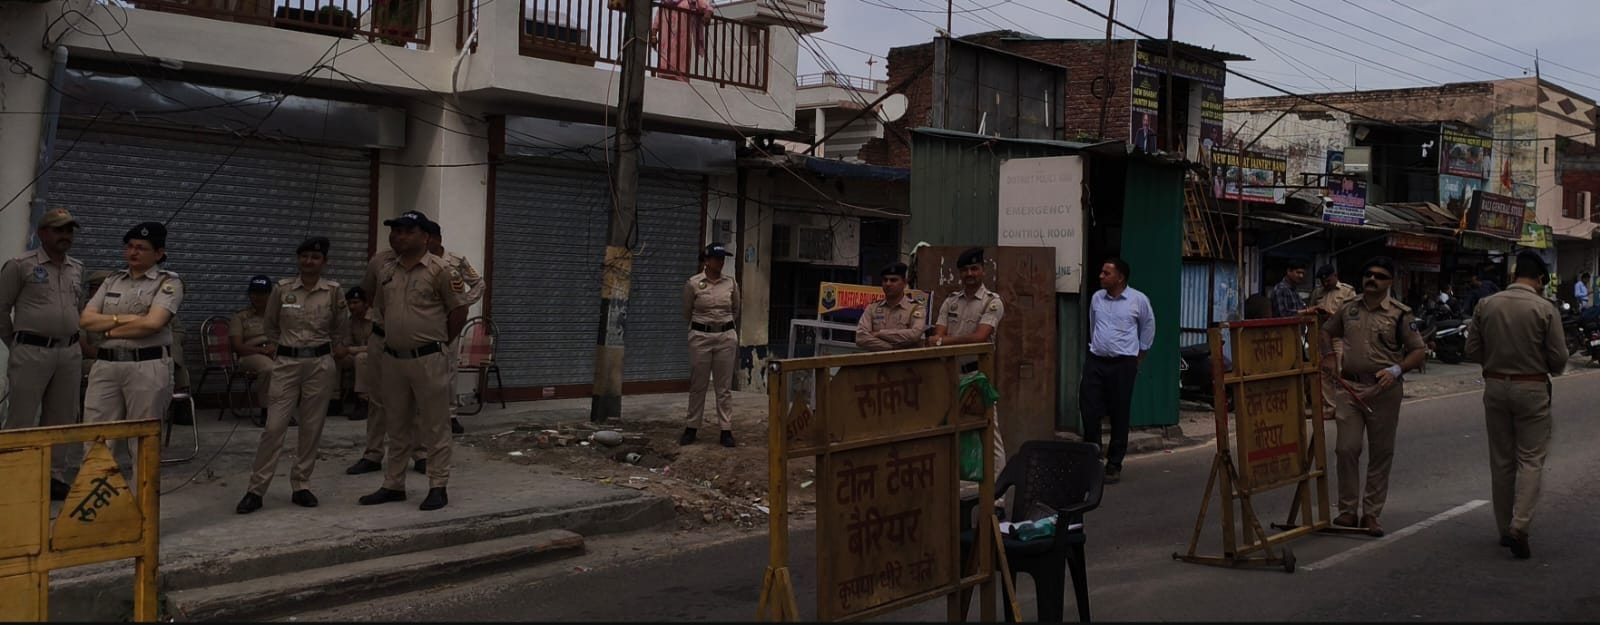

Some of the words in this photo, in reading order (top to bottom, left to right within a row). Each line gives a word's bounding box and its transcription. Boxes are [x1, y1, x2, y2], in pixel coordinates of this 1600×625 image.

[1212, 152, 1226, 165] NEW
[1227, 154, 1250, 168] BHAAT
[1006, 204, 1072, 216] EMERGENCY
[1492, 202, 1511, 215] GENERAL
[1002, 229, 1044, 239] CONTROL
[1047, 228, 1075, 238] ROOM
[785, 409, 812, 441] STOP
[836, 460, 878, 505] टोल
[886, 446, 937, 495] टैक्स
[848, 506, 922, 560] बैरियर
